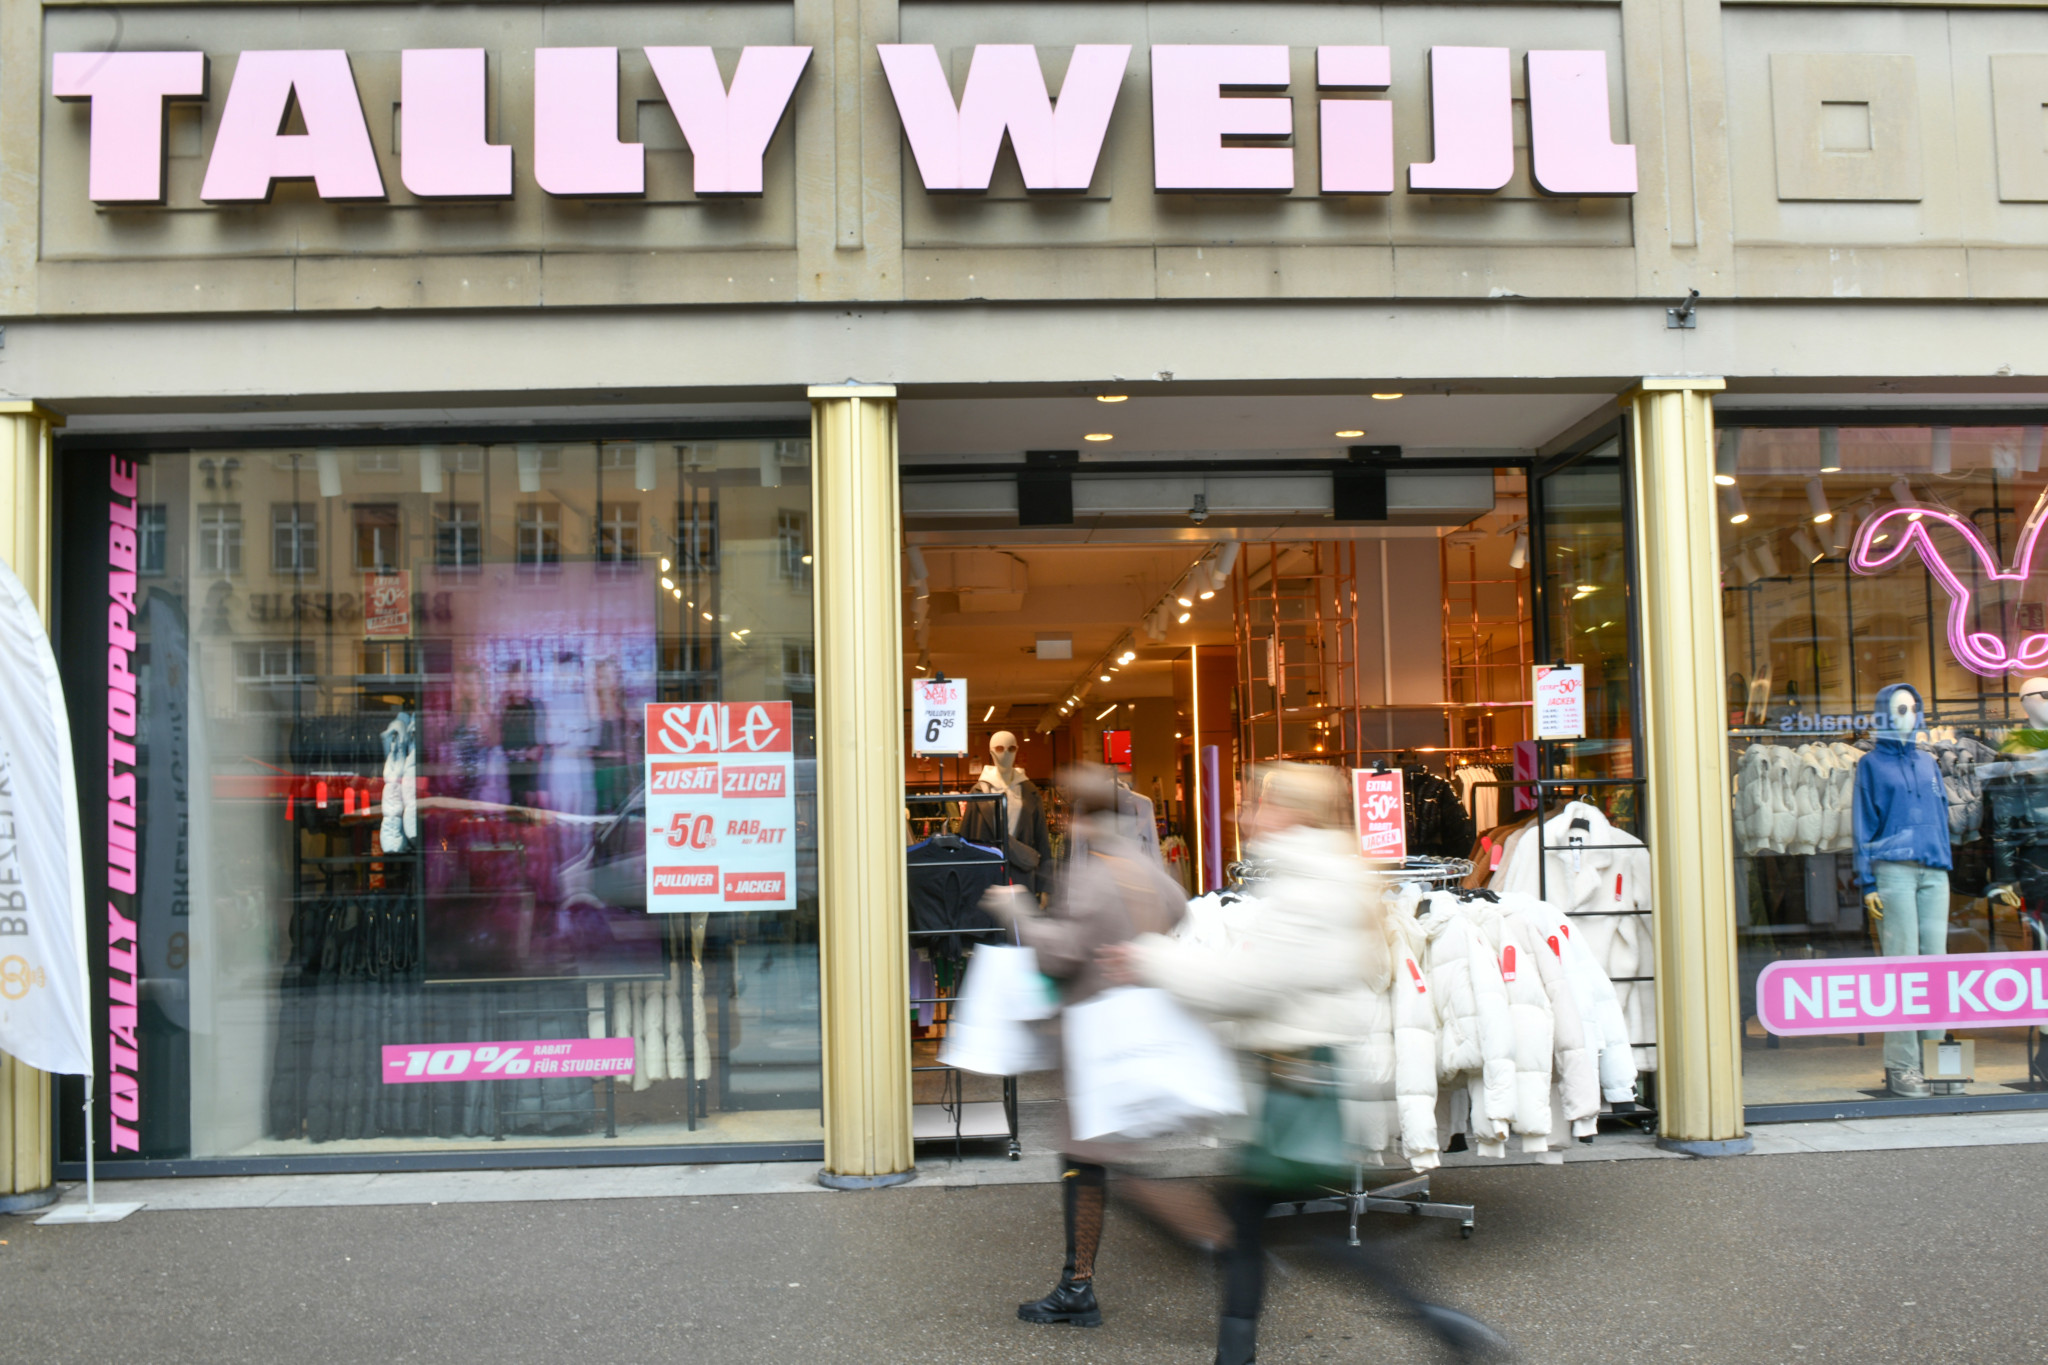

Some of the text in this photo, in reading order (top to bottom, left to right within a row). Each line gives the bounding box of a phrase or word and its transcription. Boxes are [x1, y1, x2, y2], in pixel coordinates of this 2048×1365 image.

[52, 46, 813, 202] TALLY
[1366, 780, 1392, 792] EXTRA
[107, 453, 139, 1154] TOTALLY UNSTOPPABLE
[1362, 794, 1398, 820] -50%
[1366, 832, 1397, 849] JACKEN
[654, 873, 714, 887] PULLOVER
[735, 880, 781, 894] JACKEN
[1783, 972, 1930, 1020] NEUE
[389, 1044, 572, 1076] -10% RABATT
[533, 1057, 633, 1073] FÜR STUDENTEN
